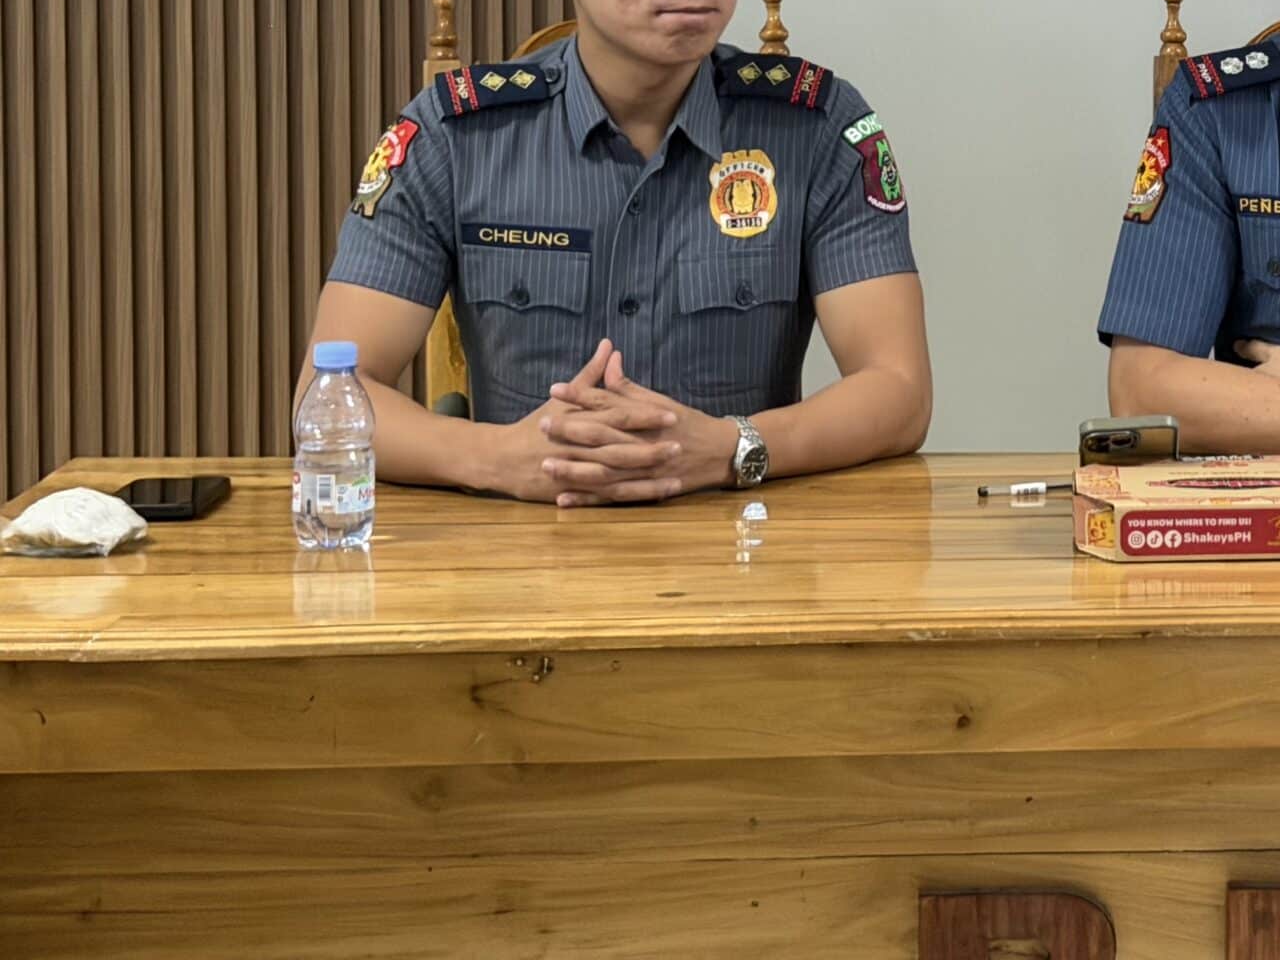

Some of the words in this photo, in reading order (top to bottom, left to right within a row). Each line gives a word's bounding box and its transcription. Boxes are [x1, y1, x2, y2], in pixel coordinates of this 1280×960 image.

[479, 227, 570, 247] CHEUNG
[1128, 519, 1145, 527] YOU
[1147, 518, 1174, 527] KNOW
[1175, 518, 1204, 527] WHERE
[1205, 518, 1217, 526] TO
[1218, 517, 1237, 526] FIND
[1183, 530, 1252, 544] ShakeysPH
